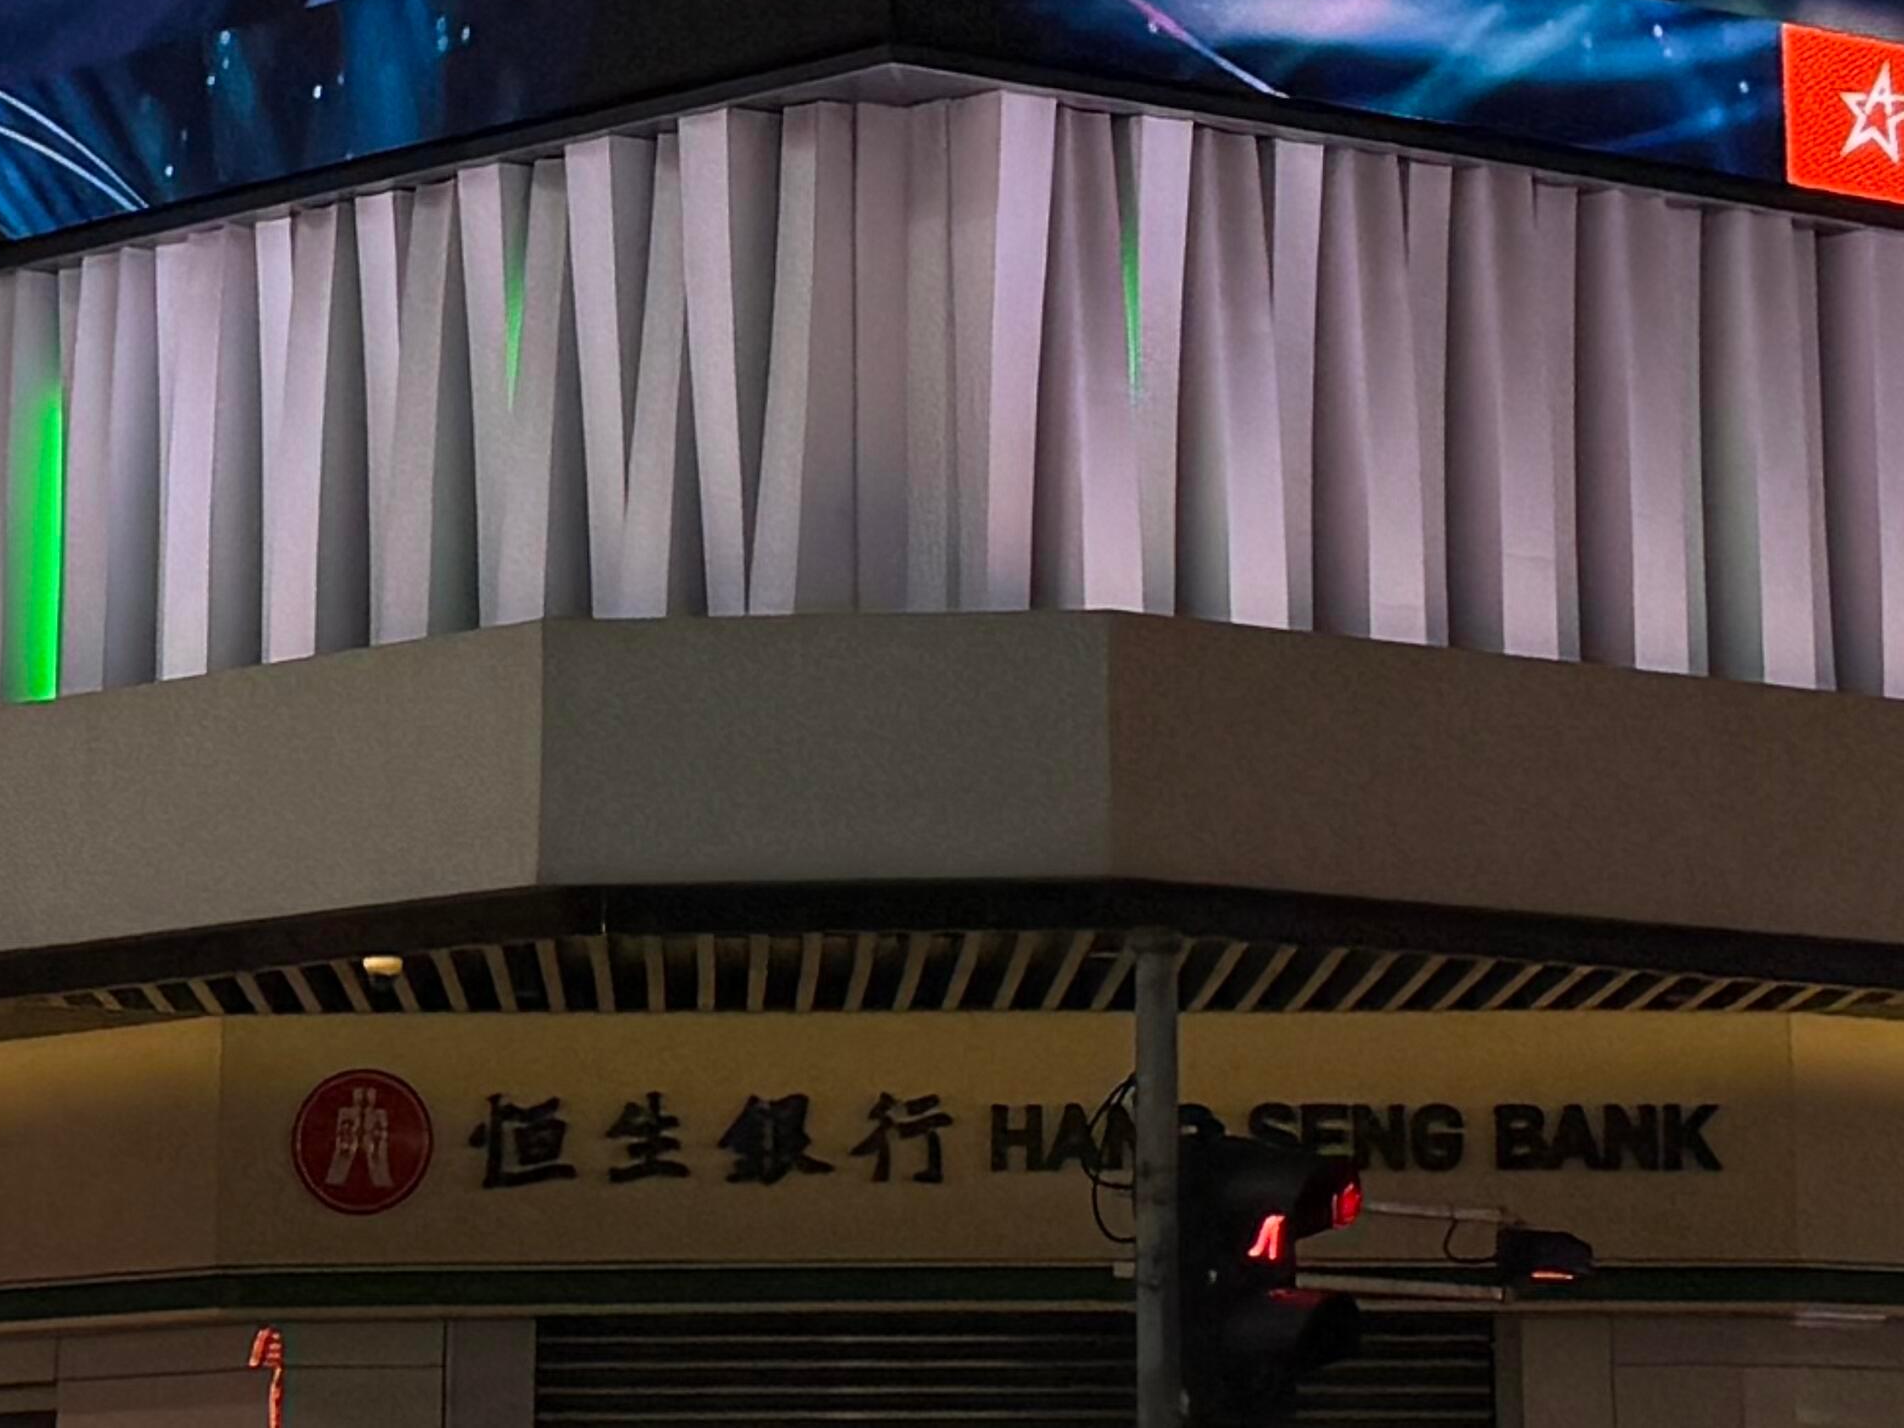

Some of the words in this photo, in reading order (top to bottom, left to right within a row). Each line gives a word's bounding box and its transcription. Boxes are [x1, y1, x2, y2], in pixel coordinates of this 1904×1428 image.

[468, 1091, 953, 1189] 恒生銀行
[1249, 1102, 1464, 1172] SENG
[1494, 1103, 1723, 1172] BANK
